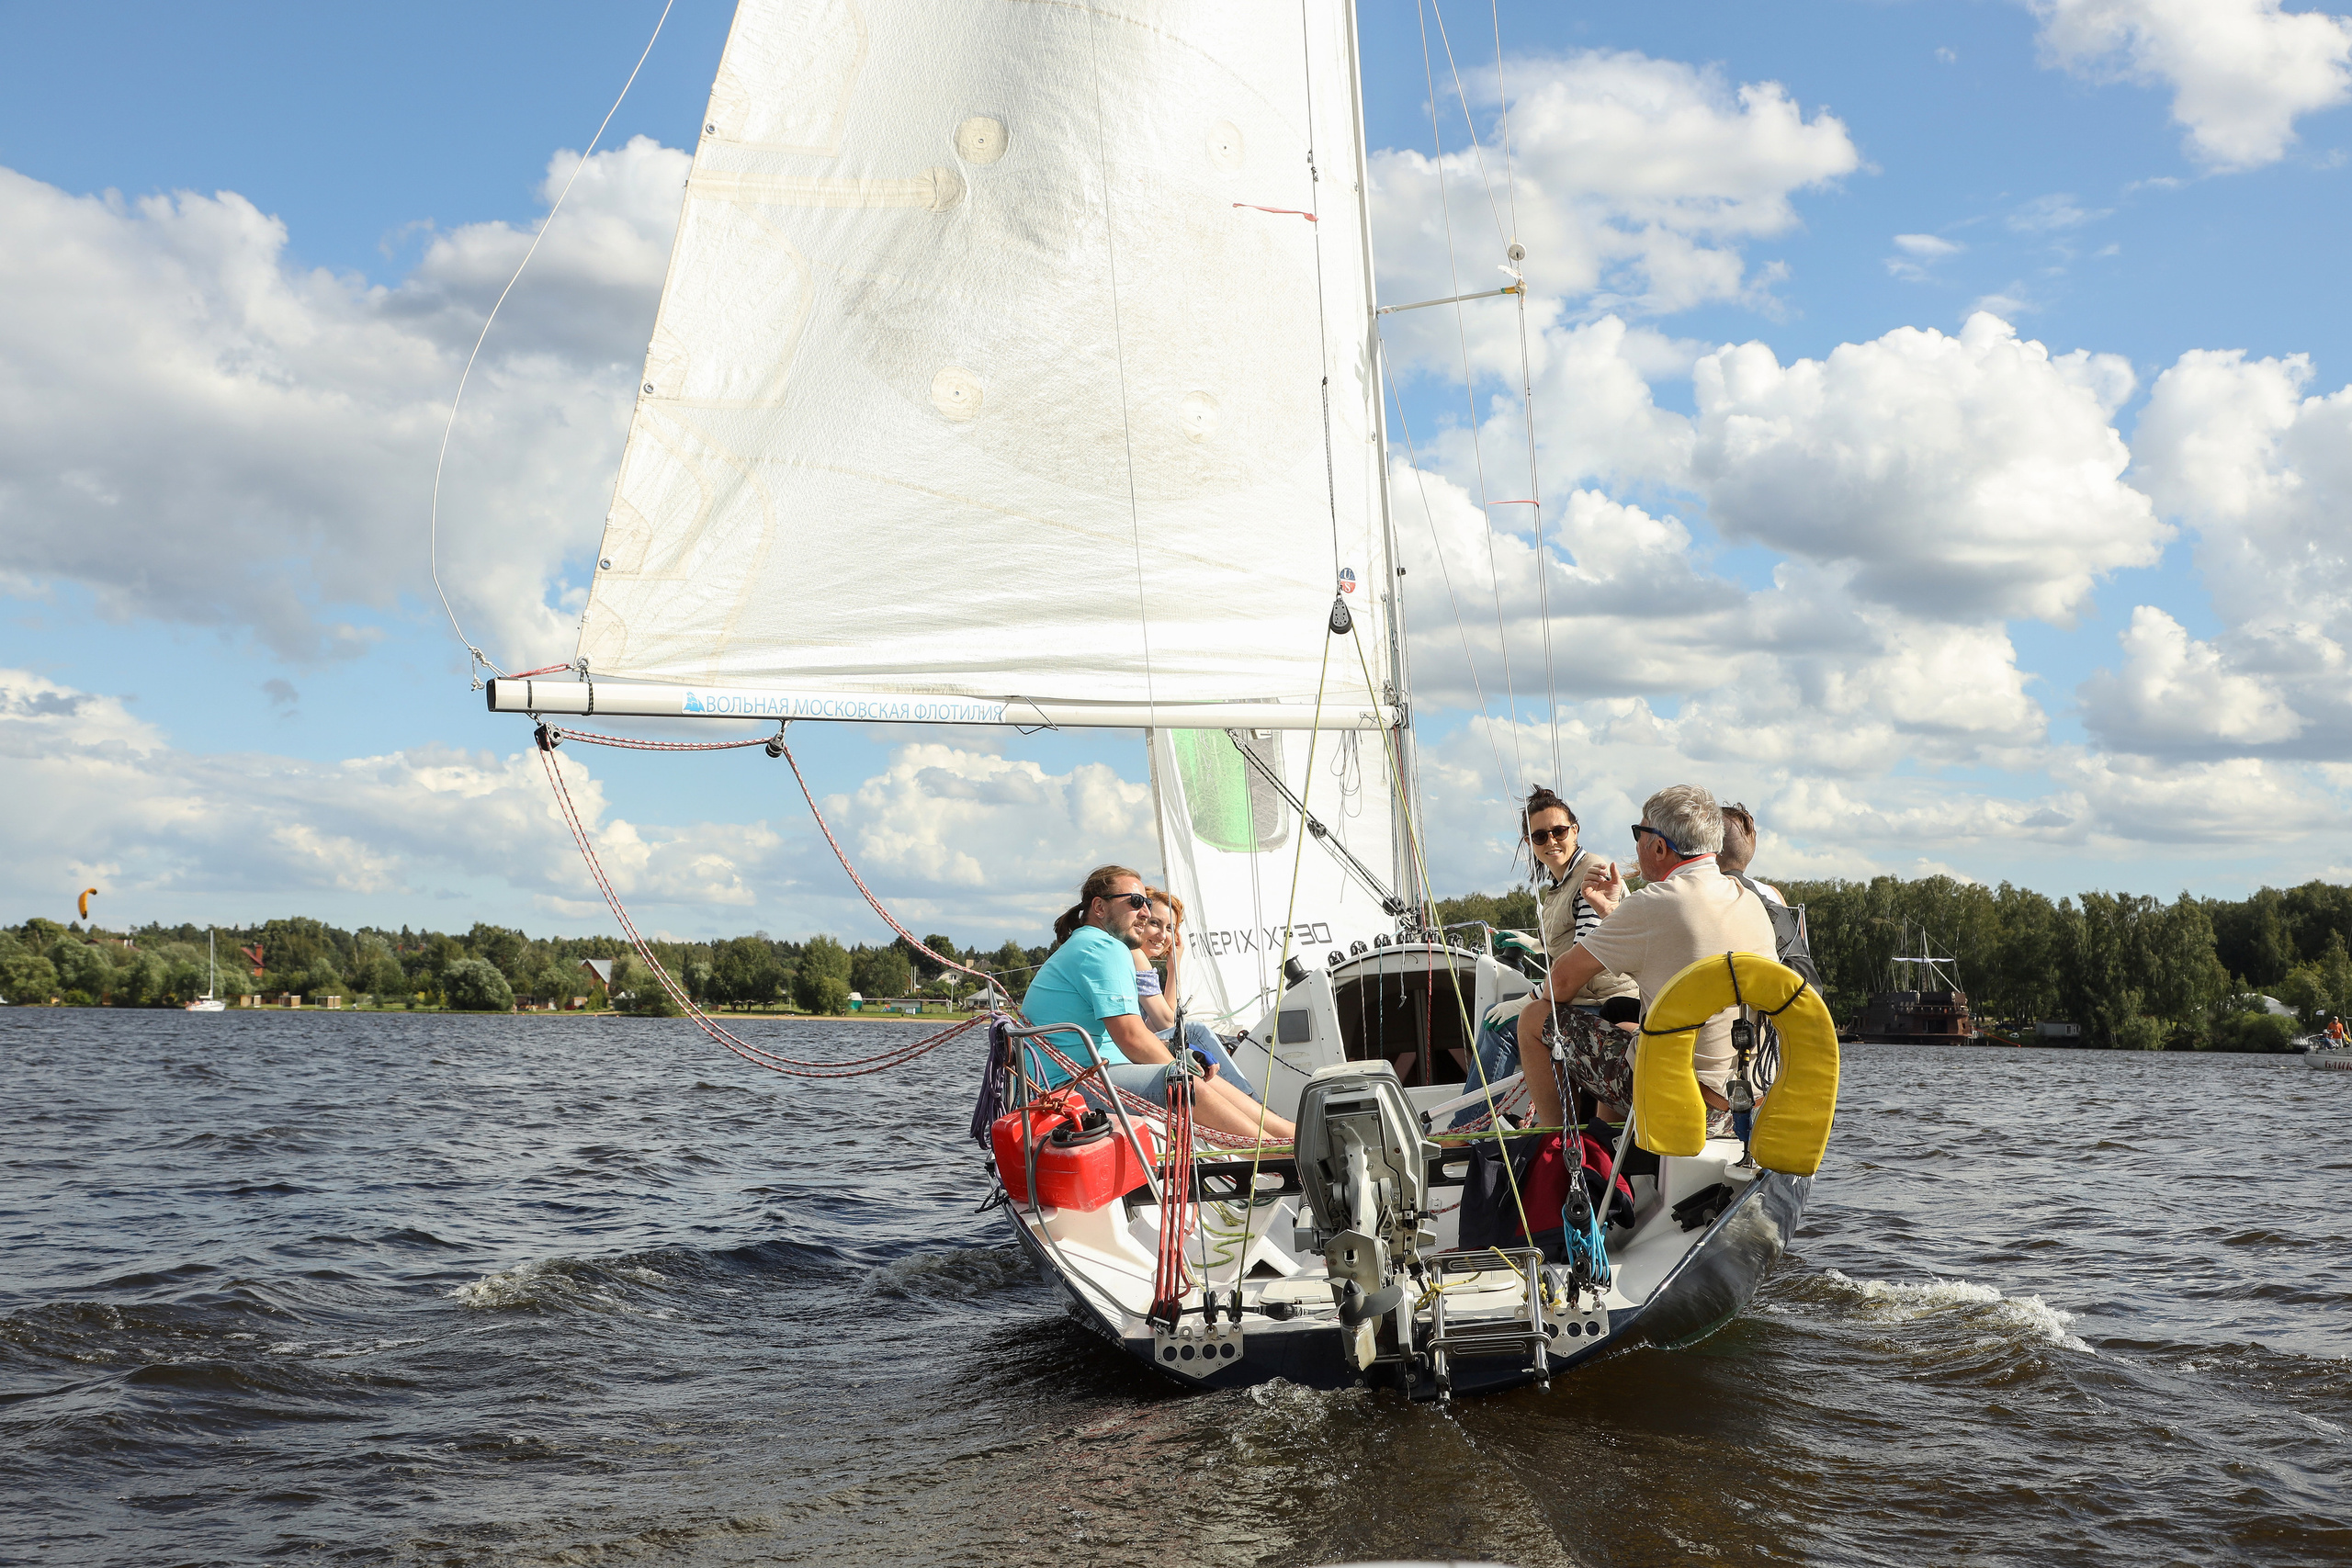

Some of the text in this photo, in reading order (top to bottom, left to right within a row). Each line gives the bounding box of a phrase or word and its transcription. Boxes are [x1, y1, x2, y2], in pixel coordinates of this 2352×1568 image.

[706, 695, 1002, 721] ВОЛЬНАЯ МОСКОВСКАЯ ФЛОТИЛИЯ
[1188, 929, 1259, 960] FINEPIX
